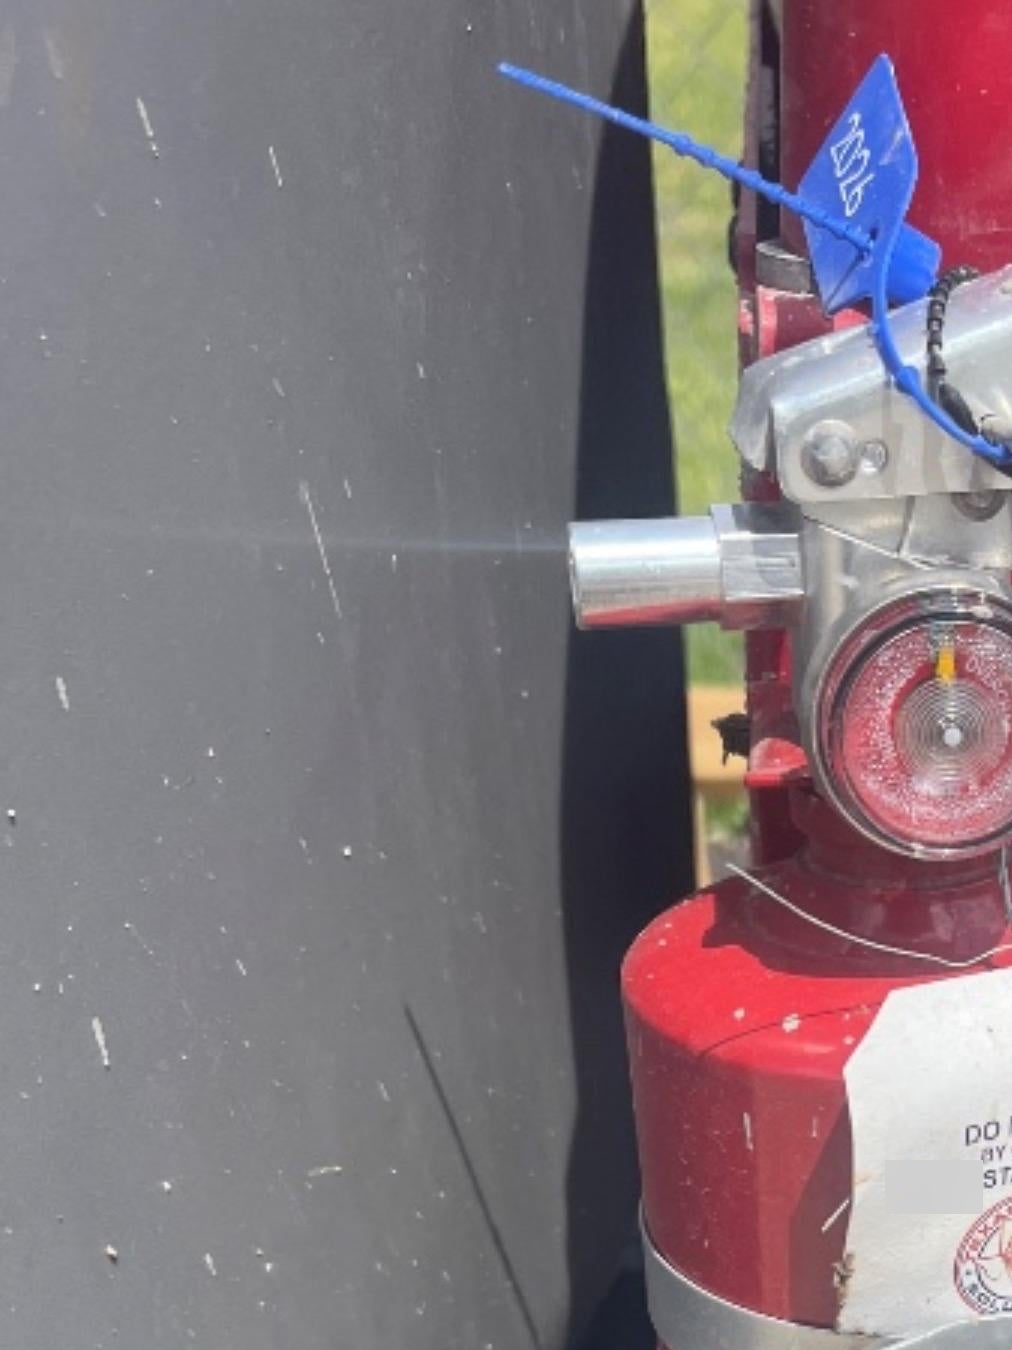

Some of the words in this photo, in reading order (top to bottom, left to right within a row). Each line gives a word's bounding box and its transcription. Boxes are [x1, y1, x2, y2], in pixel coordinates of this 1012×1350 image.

[829, 112, 876, 217] 2026
[965, 1121, 1000, 1146] DO
[981, 1145, 1006, 1164] BY
